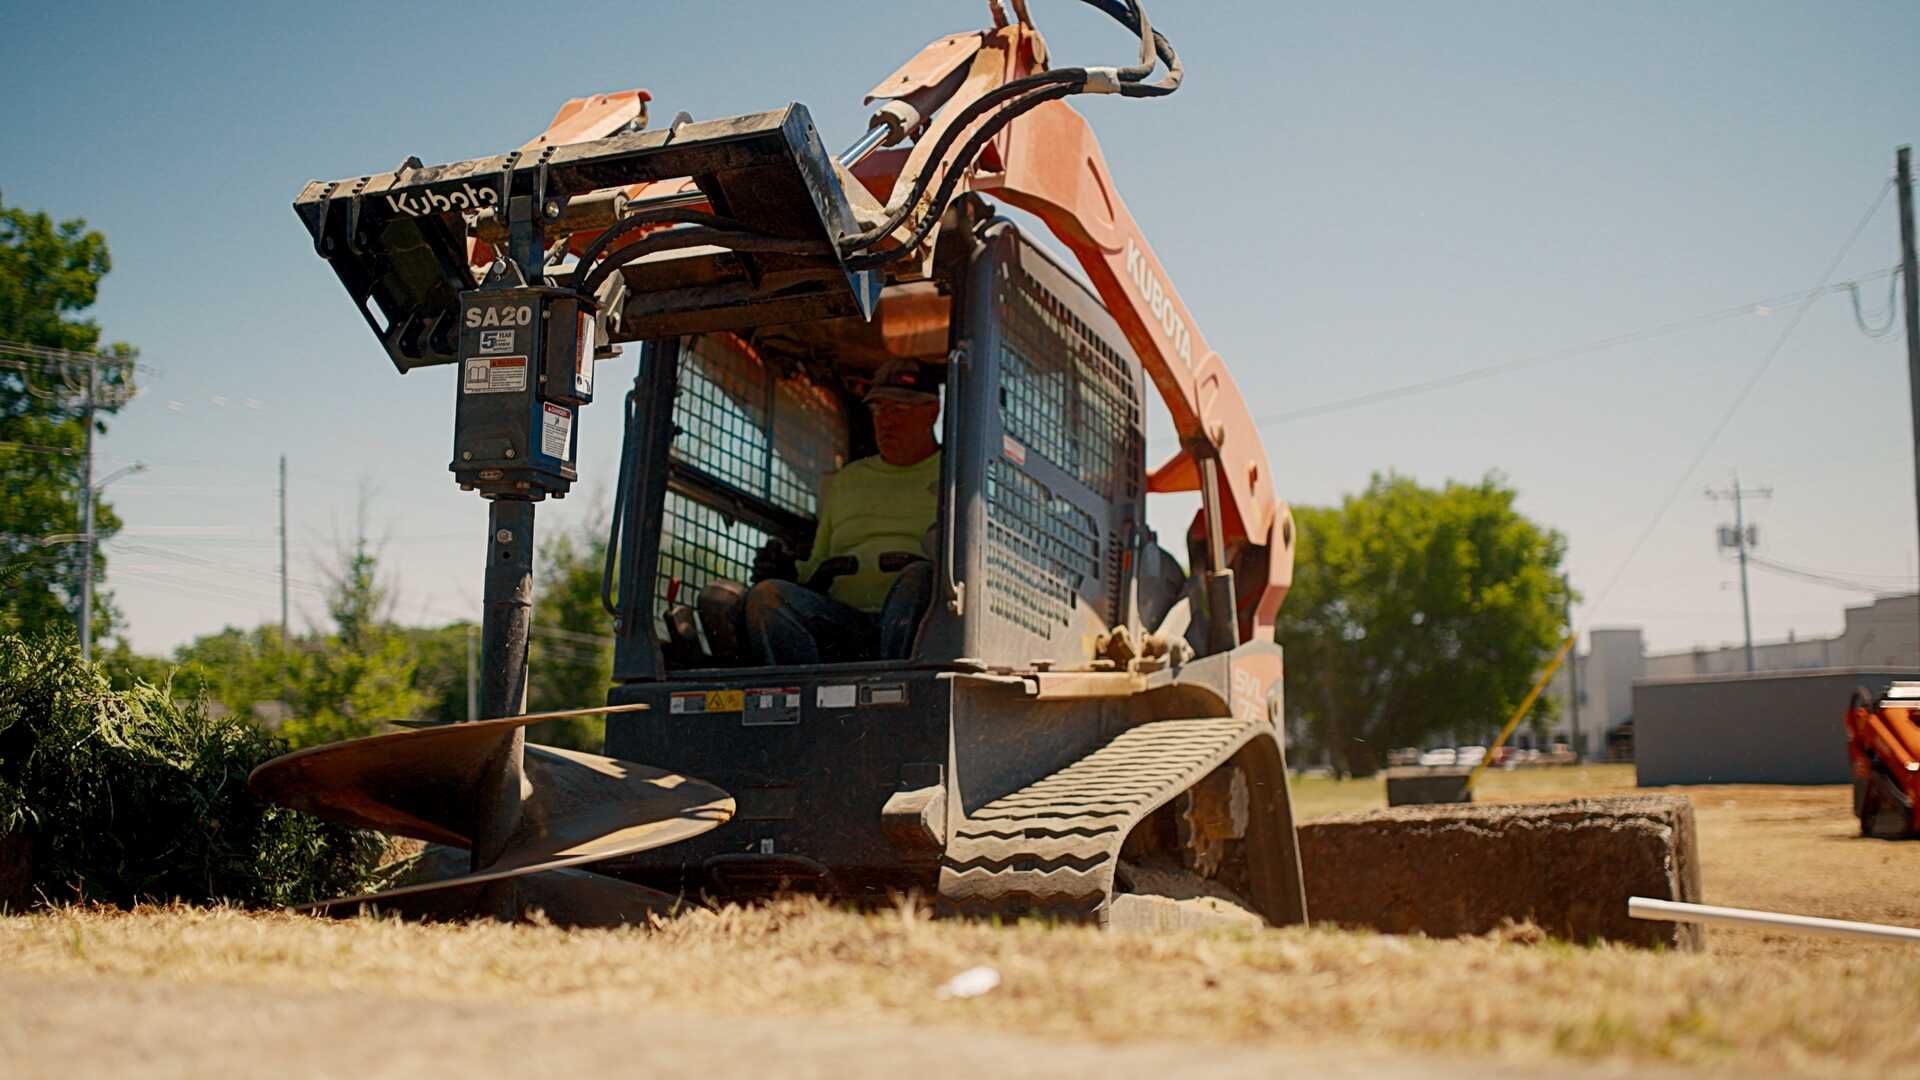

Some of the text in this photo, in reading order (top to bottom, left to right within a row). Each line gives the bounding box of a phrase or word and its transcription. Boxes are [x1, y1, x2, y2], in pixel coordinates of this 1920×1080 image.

[386, 183, 498, 217] Kubota
[466, 305, 532, 328] SA20
[1127, 237, 1192, 369] KUBOTA
[481, 332, 497, 349] 5
